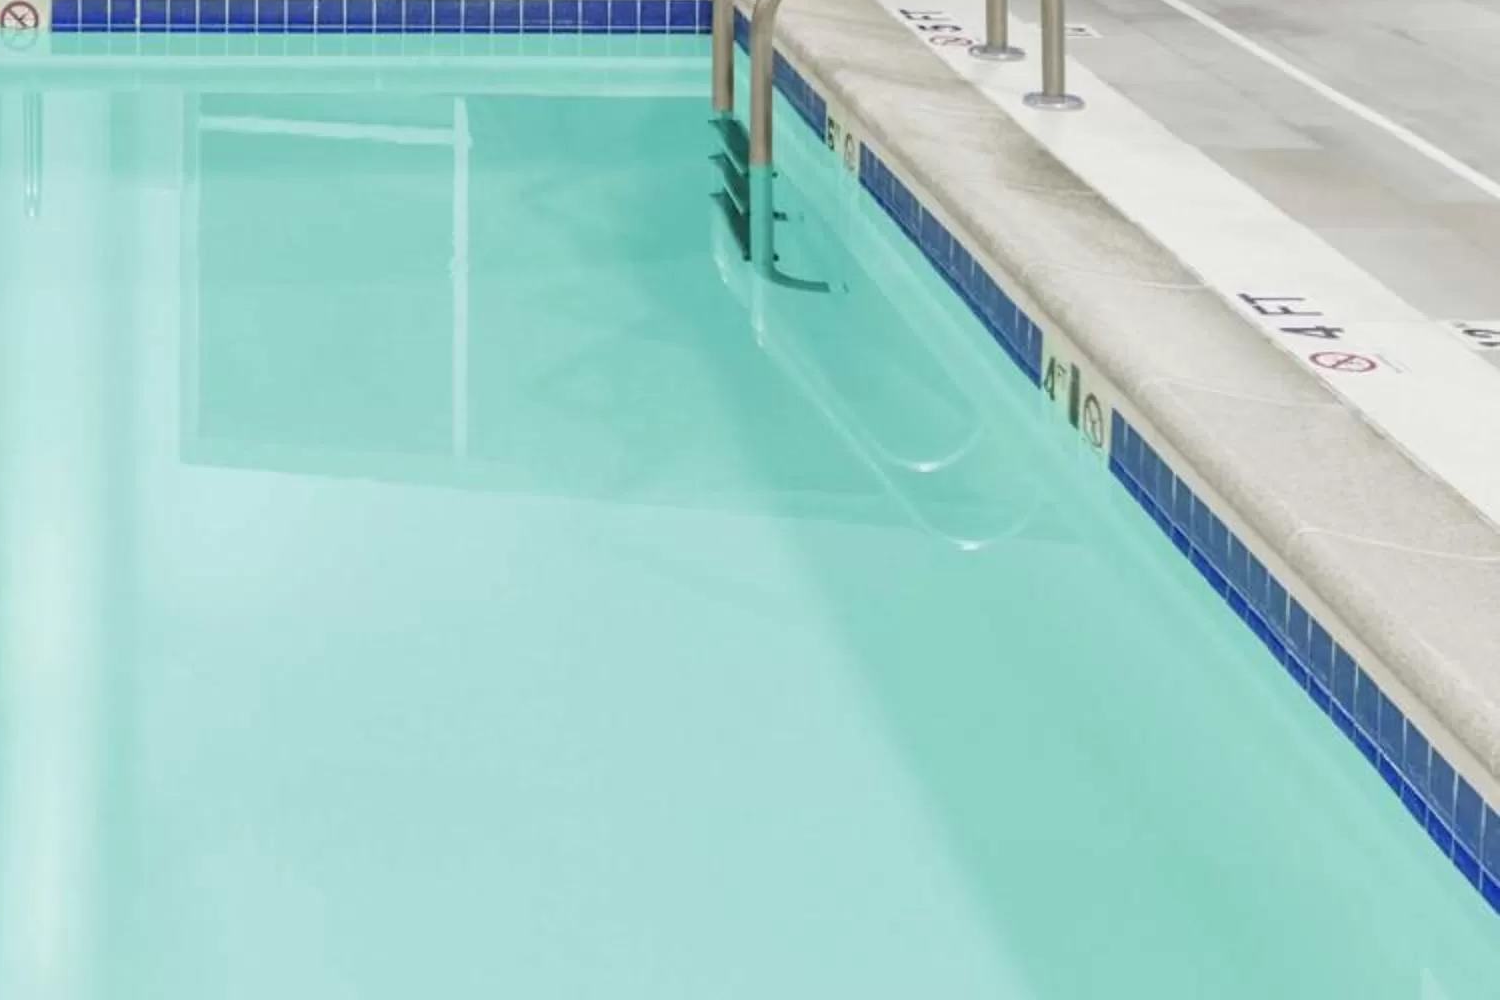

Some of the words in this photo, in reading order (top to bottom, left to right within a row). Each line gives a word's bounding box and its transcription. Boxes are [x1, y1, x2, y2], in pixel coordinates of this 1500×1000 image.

[1237, 293, 1324, 316] FT
[1280, 325, 1345, 340] 4
[1043, 356, 1056, 401] 4
